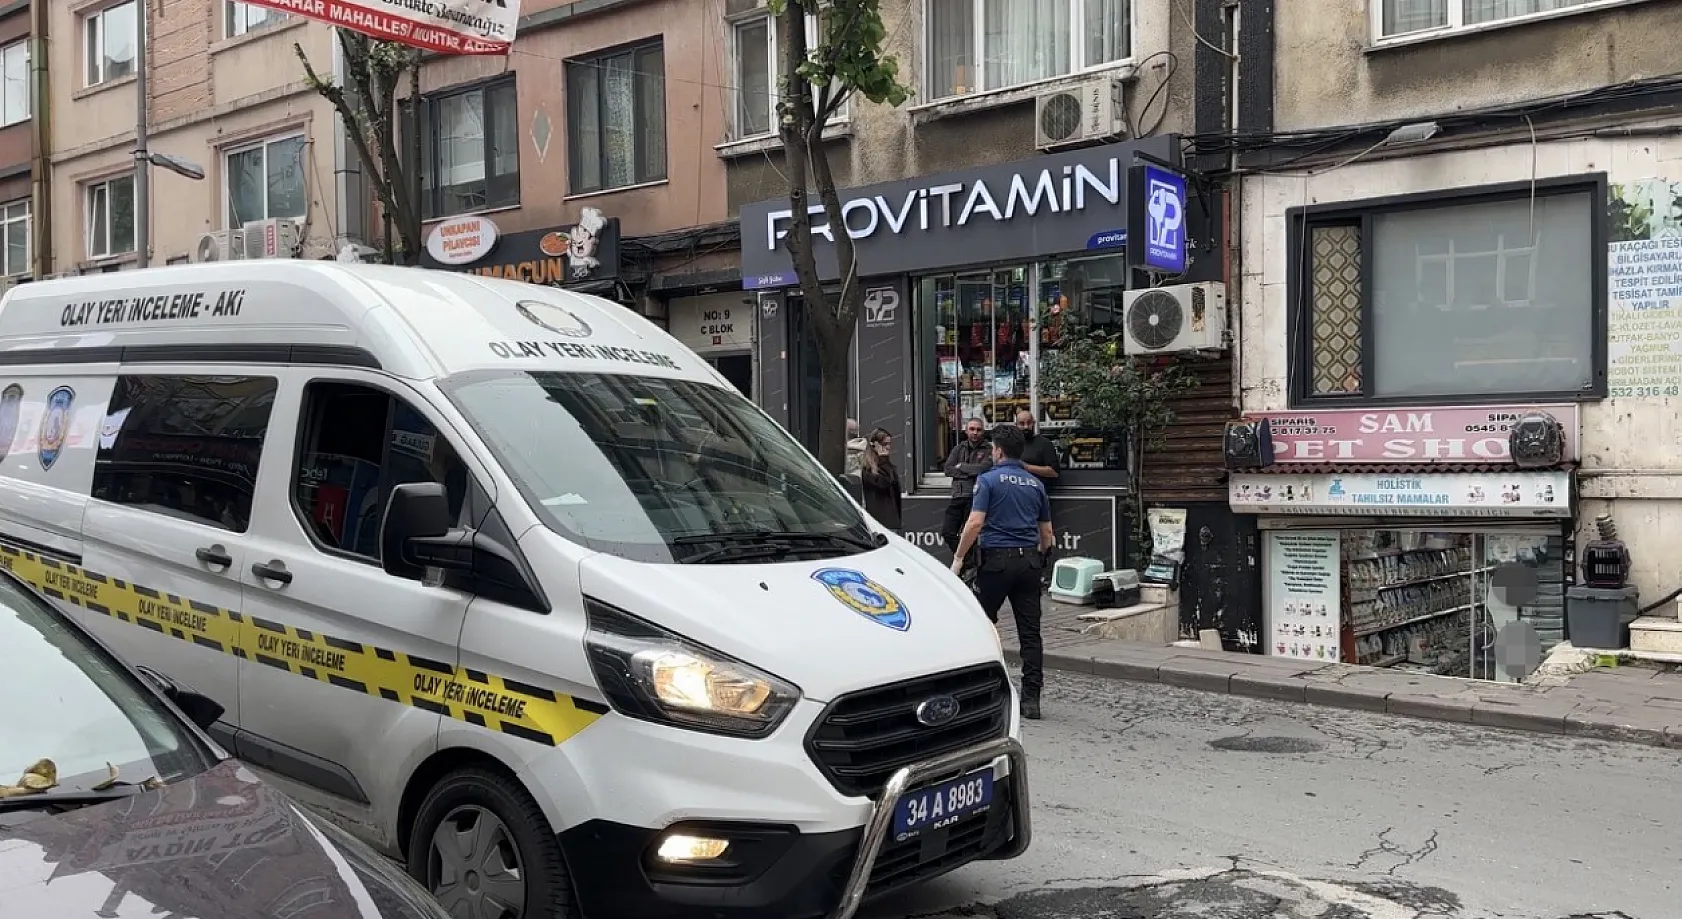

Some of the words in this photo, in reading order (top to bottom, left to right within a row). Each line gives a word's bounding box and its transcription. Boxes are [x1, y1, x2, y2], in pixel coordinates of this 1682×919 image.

[329, 4, 413, 38] MAHALLESİ
[1611, 265, 1644, 276] HAZLA
[61, 302, 96, 327] OLAY
[724, 309, 730, 320] 9
[709, 323, 734, 334] BLOK
[489, 341, 546, 359] OLAY
[1609, 386, 1633, 398] 532
[1636, 386, 1660, 397] 316
[1663, 385, 1680, 396] 48
[1305, 427, 1318, 435] 37
[1323, 426, 1336, 434] 75
[1359, 412, 1434, 434] SAM
[1465, 424, 1497, 432] 0545
[1382, 437, 1511, 459] SHO
[1352, 493, 1395, 504] TAHILSIZ
[1397, 492, 1450, 504] MAMALAR
[45, 569, 60, 585] OLAY
[138, 599, 156, 617] OLAY
[258, 634, 279, 654] OLAY
[413, 673, 441, 696] OLAY
[907, 795, 928, 826] 34
[931, 791, 943, 818] A
[948, 778, 983, 813] 8983
[934, 815, 959, 829] KAR
